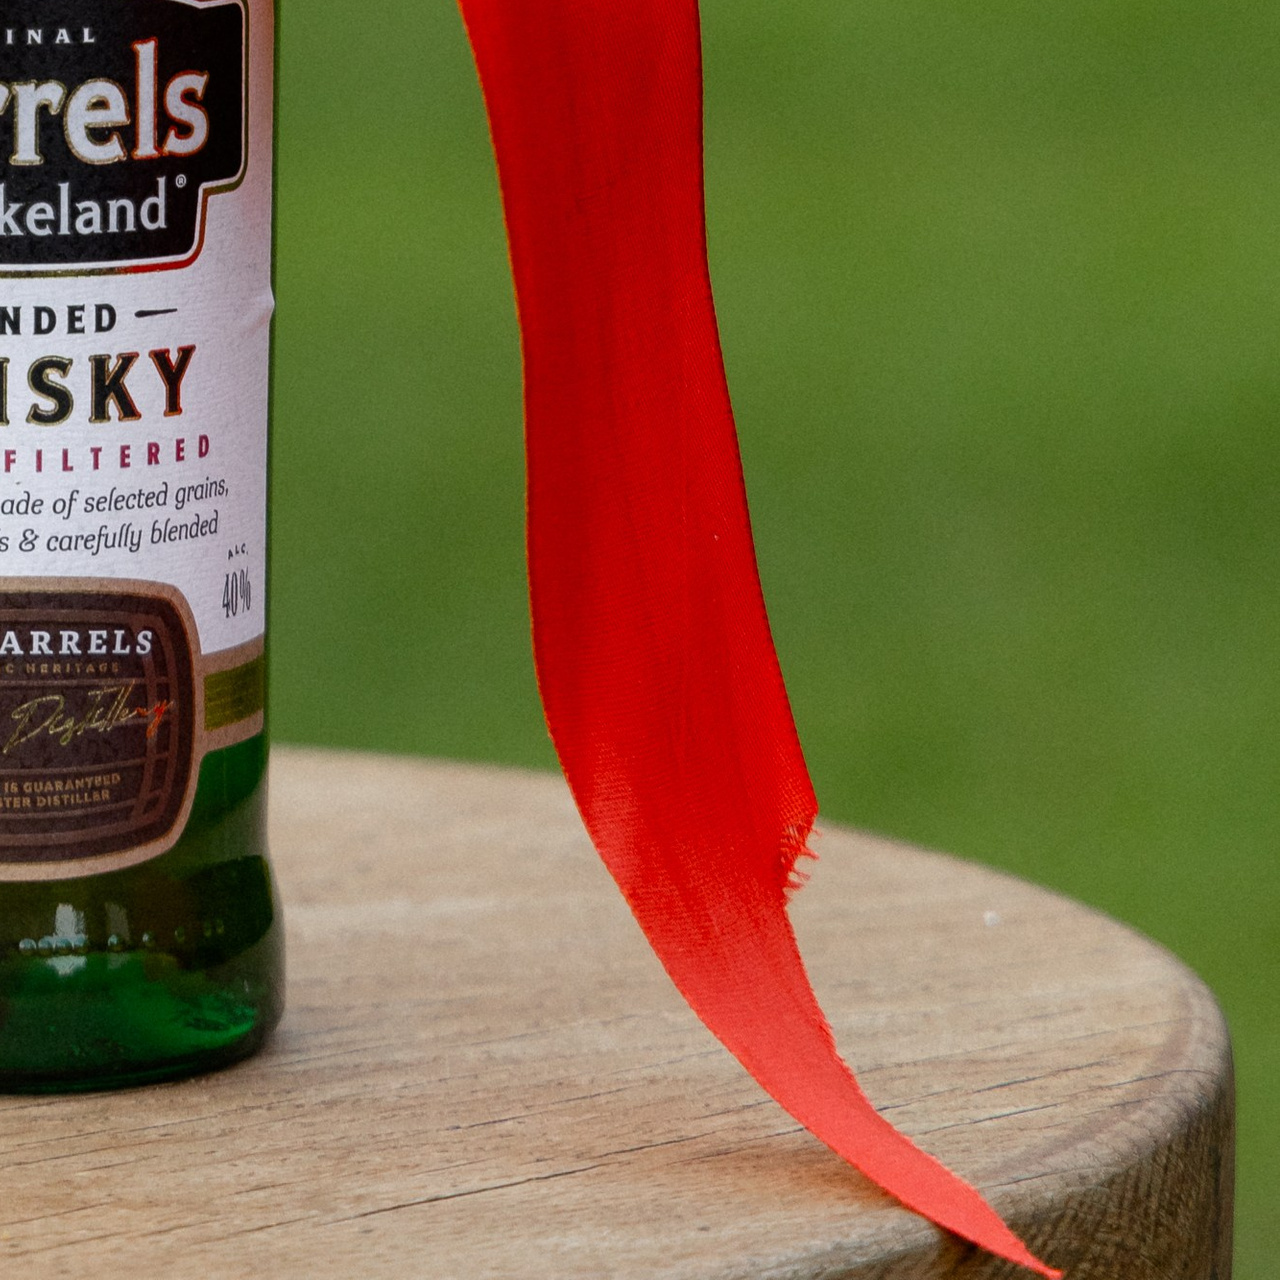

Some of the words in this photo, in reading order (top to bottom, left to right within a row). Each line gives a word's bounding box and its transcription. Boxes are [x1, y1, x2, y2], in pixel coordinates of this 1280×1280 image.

[4, 433, 210, 473] FILTERED
[52, 490, 79, 520] of
[83, 481, 169, 514] selected
[174, 476, 229, 511] grains,
[18, 528, 39, 553] &
[46, 522, 143, 556] carefully
[150, 509, 219, 544] blended
[221, 565, 252, 619] 40%
[25, 662, 120, 675] HERITAGE
[3, 781, 19, 794] IS
[23, 772, 121, 793] GUARANTEED
[36, 789, 111, 808] DISTILLER
